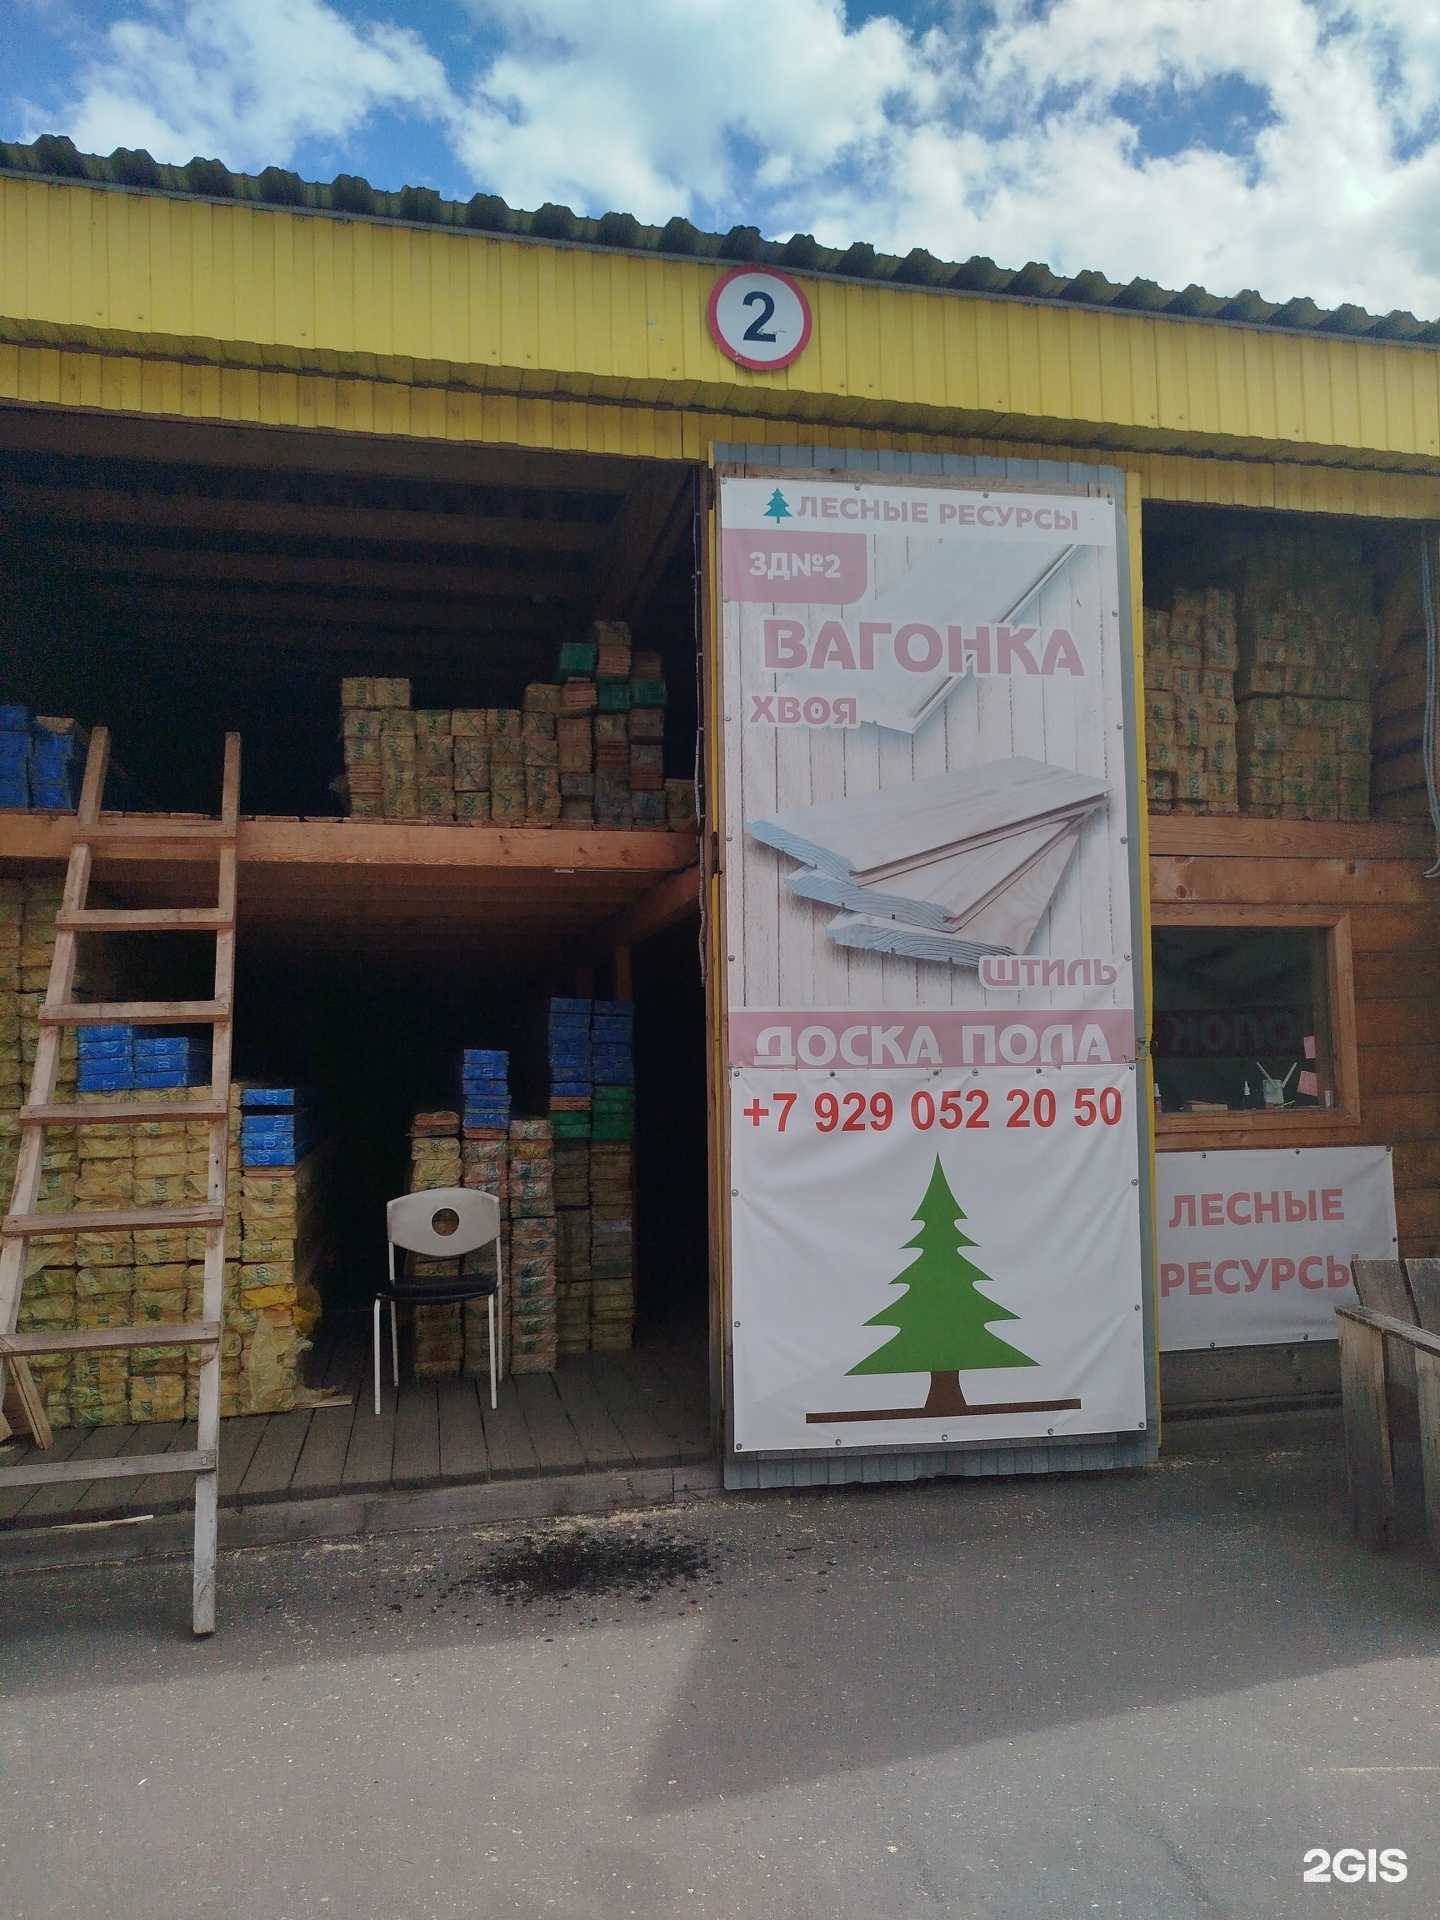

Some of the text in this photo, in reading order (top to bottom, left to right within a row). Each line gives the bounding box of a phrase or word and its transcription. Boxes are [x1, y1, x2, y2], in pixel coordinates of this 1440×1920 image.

[742, 291, 776, 343] 2
[797, 496, 1079, 531] ЛЕСНЫЕ РЕСУРСЫ
[763, 620, 1086, 677] ВАГОНКА
[749, 695, 858, 726] ХВОЯ
[982, 958, 1119, 987] ШТИЛЬ
[753, 1025, 942, 1066] ДОСКА
[961, 1023, 1113, 1063] ПОЛА
[743, 1086, 1123, 1133] +7 929 052 20 50
[1168, 1188, 1345, 1228] ЛЕСНЫЕ
